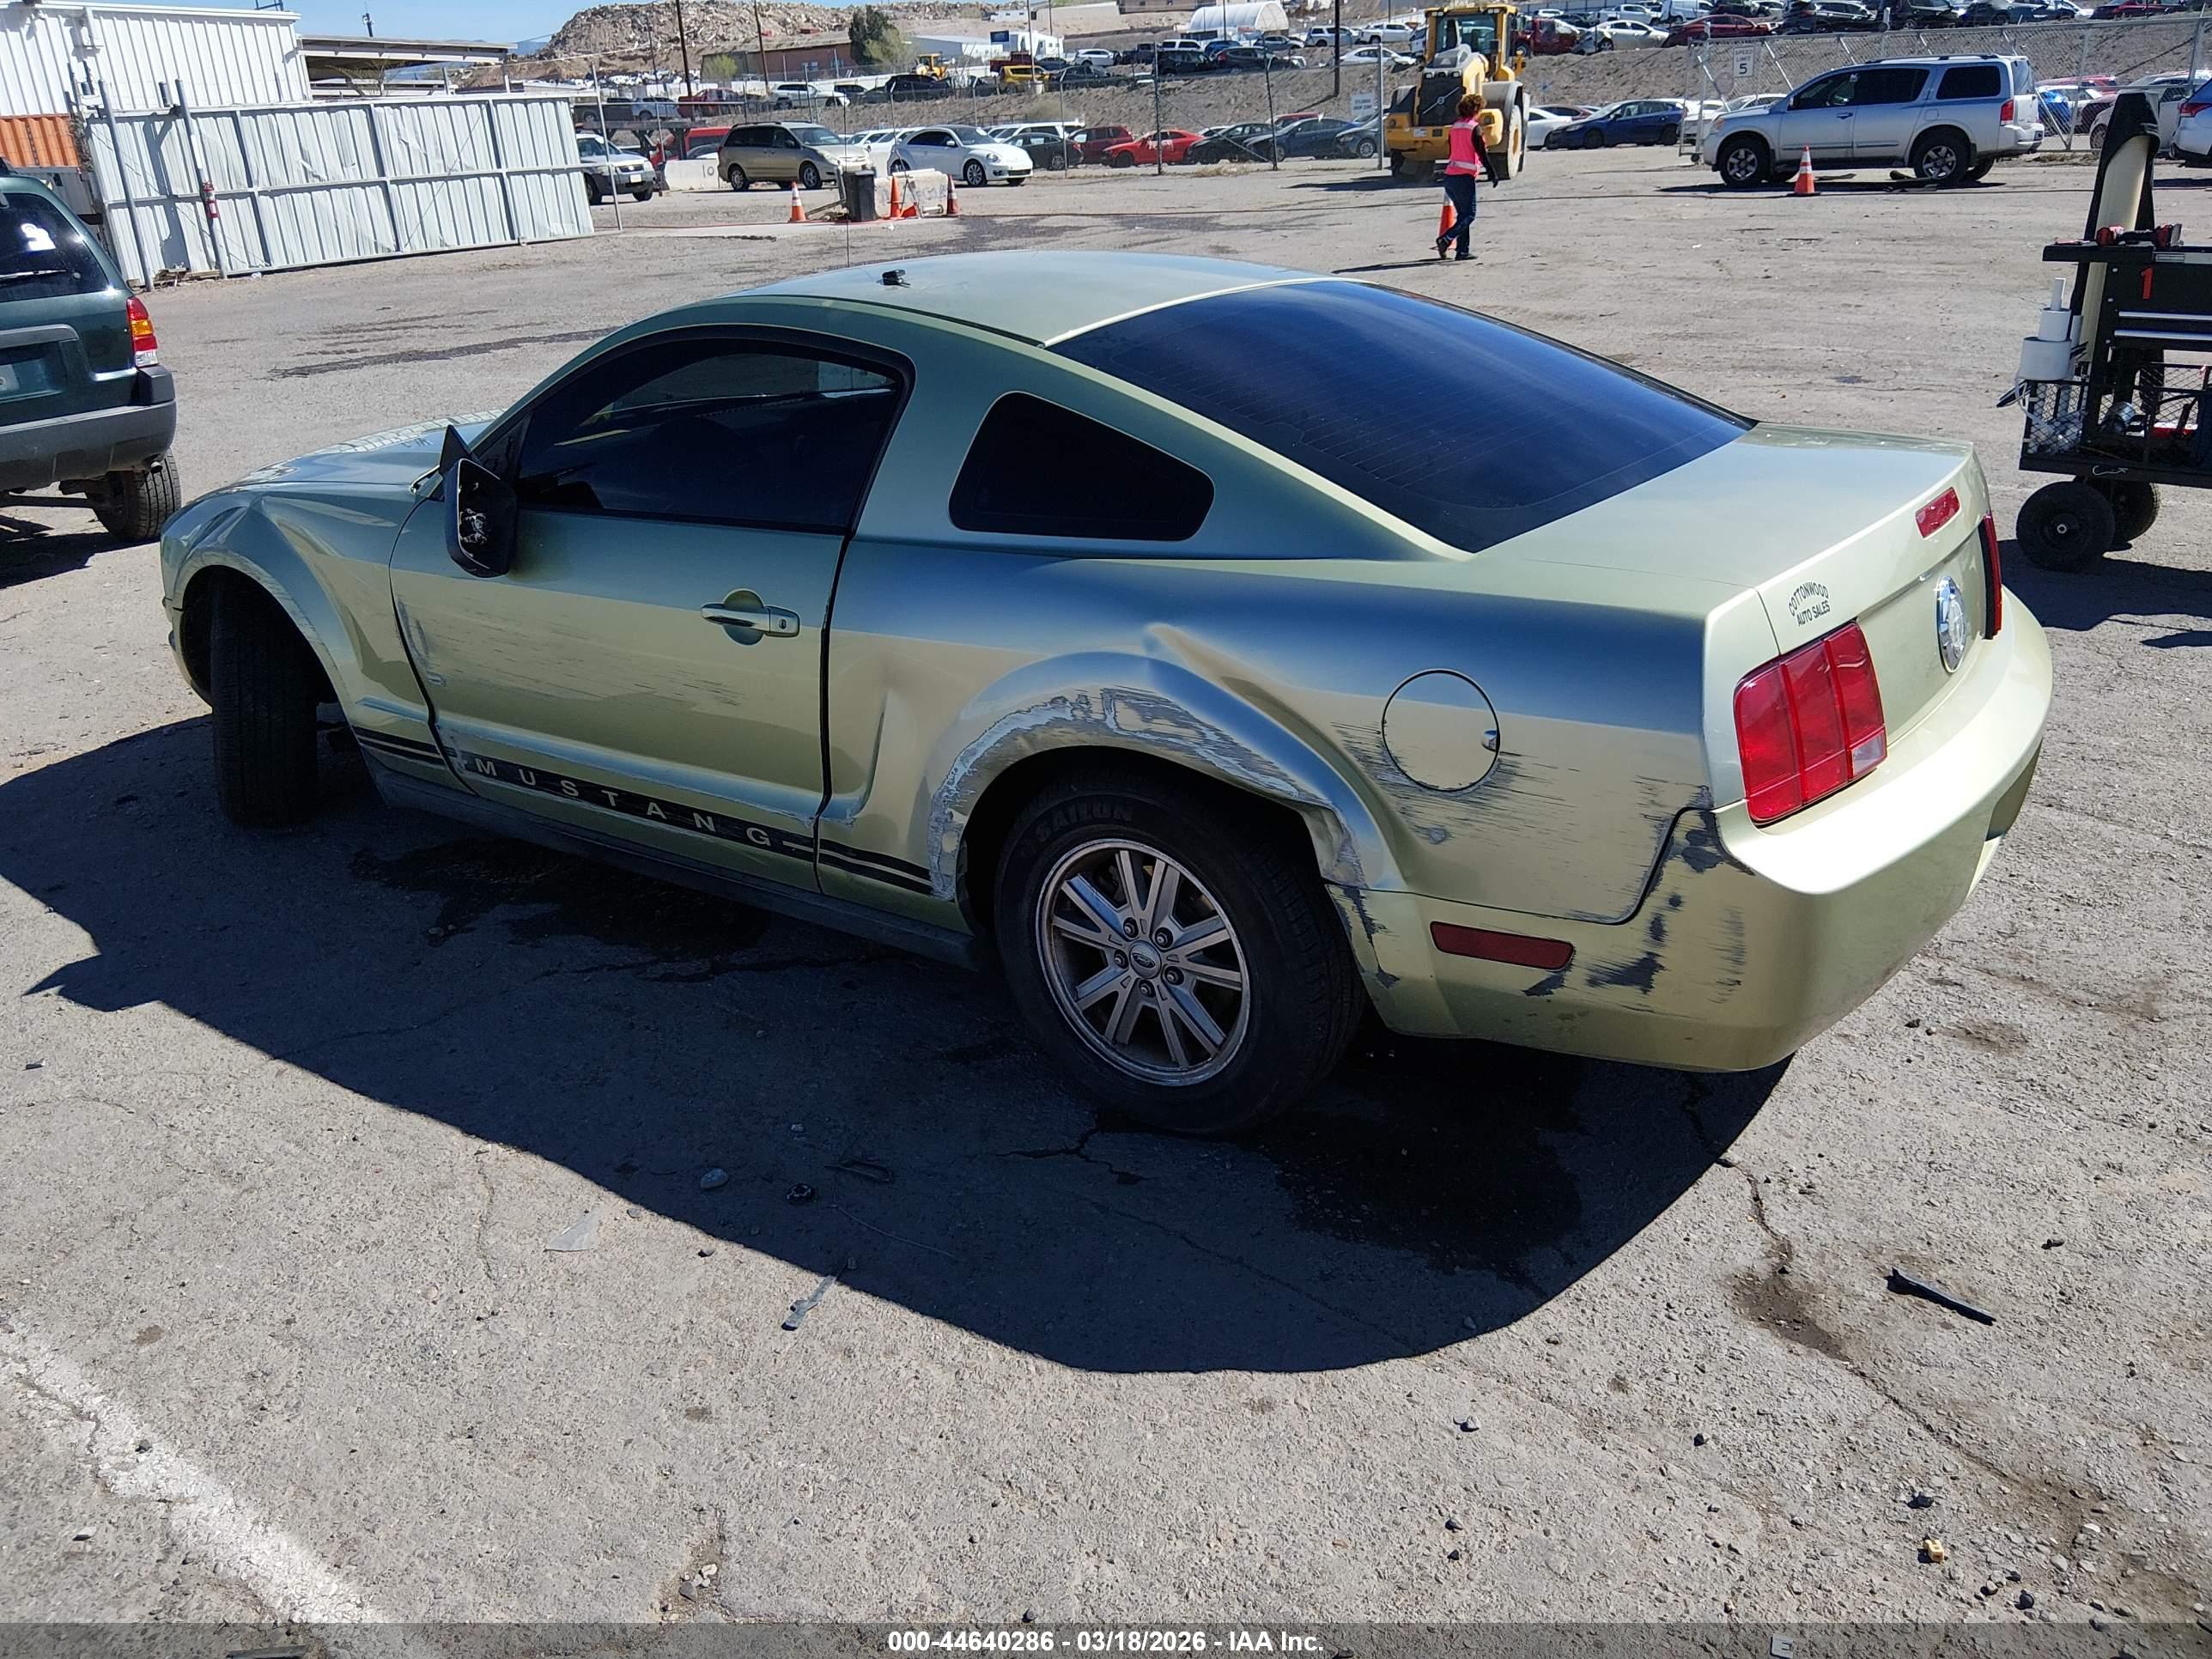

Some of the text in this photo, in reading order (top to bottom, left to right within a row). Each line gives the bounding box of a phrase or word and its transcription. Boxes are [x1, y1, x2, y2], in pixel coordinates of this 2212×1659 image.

[1739, 63, 1747, 74] 5
[702, 164, 715, 179] 10
[2141, 267, 2154, 300] 1
[1788, 581, 1829, 617] COTTONWOOD
[1796, 599, 1831, 627] AUTO SALES
[475, 757, 771, 847] MUSTANG
